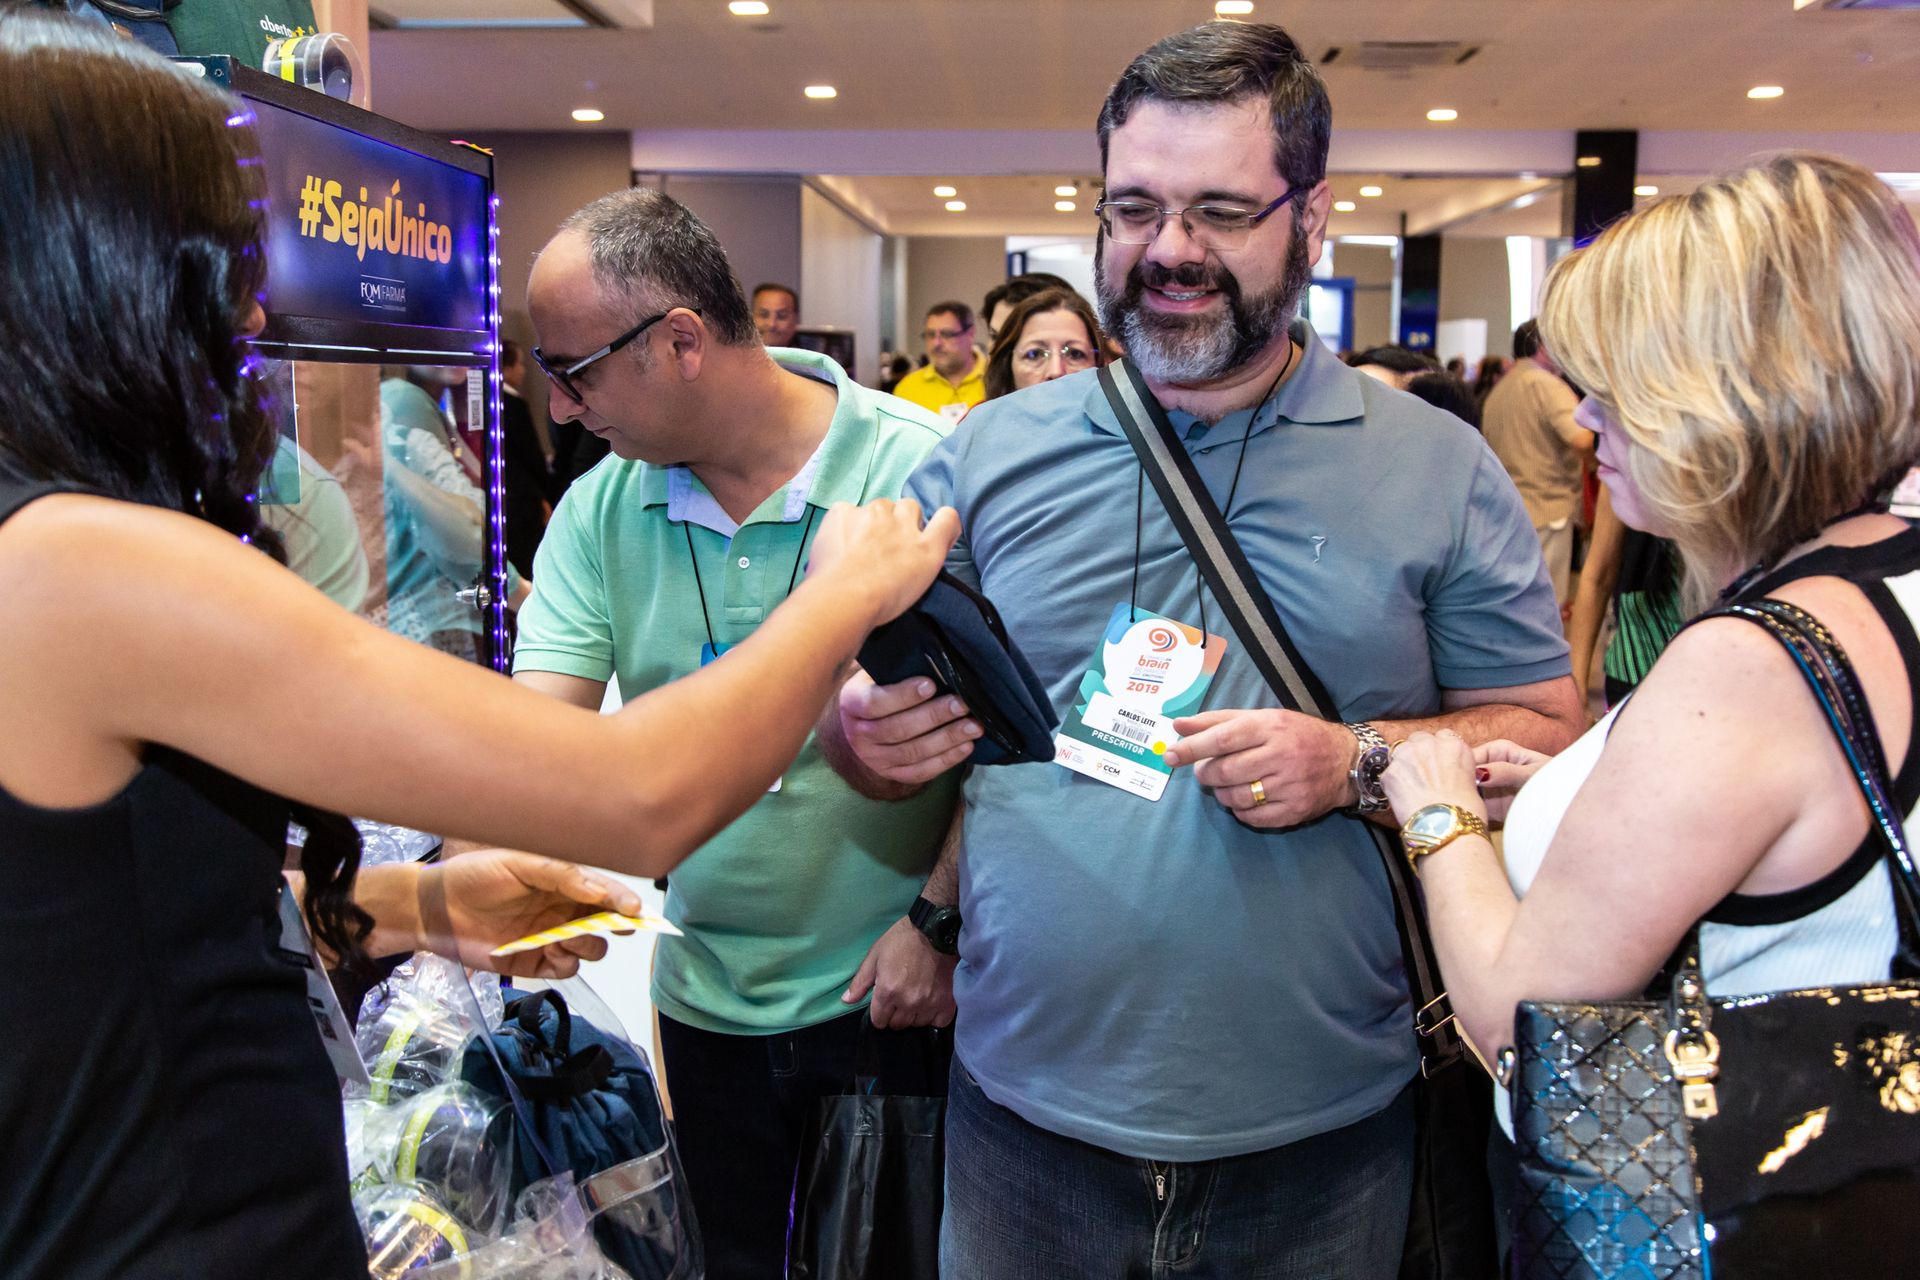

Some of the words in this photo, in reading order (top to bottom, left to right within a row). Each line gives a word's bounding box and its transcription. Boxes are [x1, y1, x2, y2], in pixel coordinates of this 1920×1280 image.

[298, 175, 452, 264] #SejaÚnico
[360, 281, 381, 303] FQM
[381, 285, 406, 303] FARMA
[1137, 655, 1170, 670] brain
[1126, 681, 1160, 694] 2019
[1118, 708, 1141, 722] CARLOS
[1140, 716, 1156, 728] LEITE
[1091, 729, 1146, 756] PRESCRITOR
[1103, 764, 1121, 776] CCM
